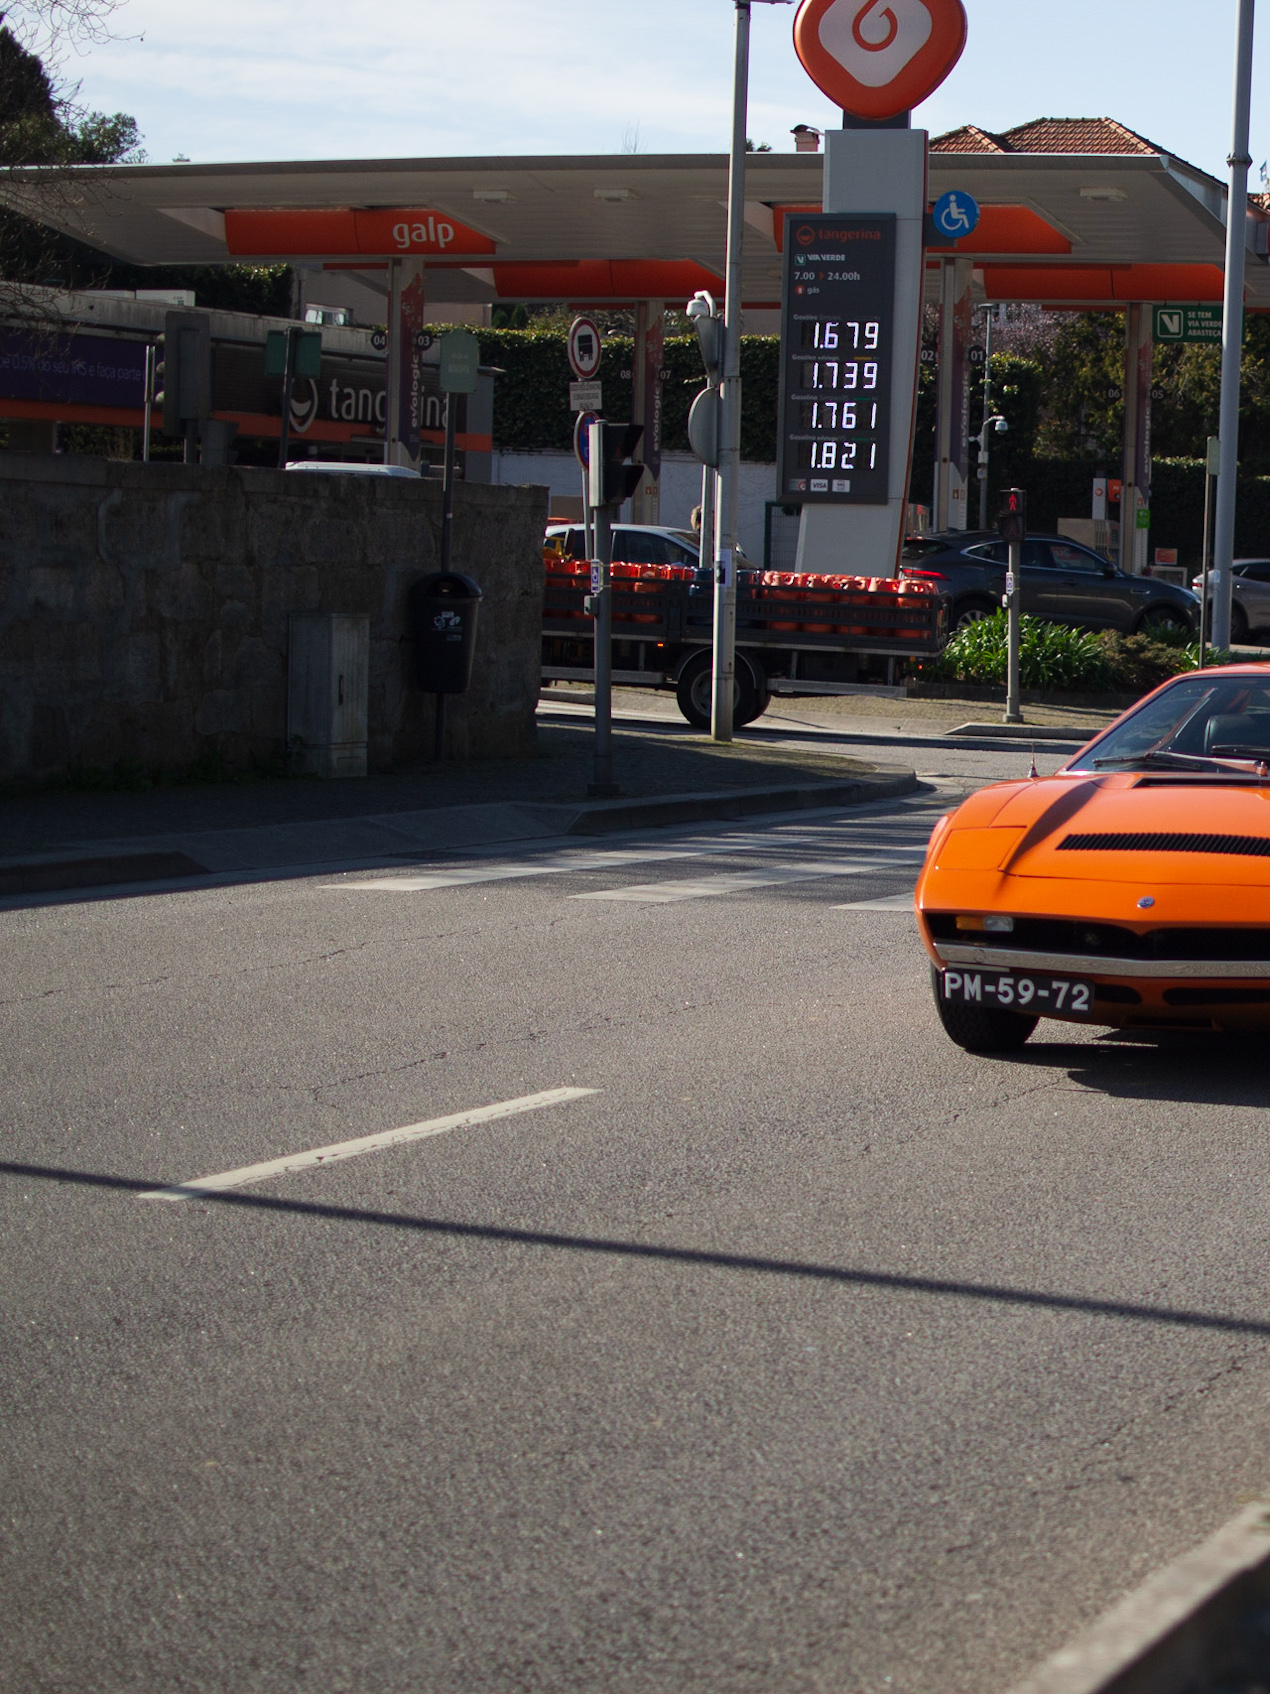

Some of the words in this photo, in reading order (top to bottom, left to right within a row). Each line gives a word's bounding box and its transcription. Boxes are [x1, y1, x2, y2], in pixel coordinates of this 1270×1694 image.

[392, 216, 455, 249] galp
[819, 228, 882, 244] tangerina
[807, 254, 821, 262] VIA
[821, 254, 846, 262] VERDE
[794, 271, 816, 281] 7.00
[827, 270, 861, 281] 24.00h
[1187, 311, 1197, 319] SE
[1198, 311, 1212, 319] TEM
[1187, 320, 1200, 328] VIA
[1201, 320, 1223, 329] VERDE
[373, 334, 386, 346] 04
[417, 334, 431, 347] 03
[813, 321, 880, 350] 1.679
[921, 350, 935, 361] 02
[970, 350, 984, 361] 01
[38, 358, 51, 373] do
[52, 361, 69, 375] seu
[89, 364, 97, 376] e
[97, 361, 115, 380] faça
[117, 367, 141, 383] parte
[660, 370, 672, 380] 07
[812, 361, 879, 389] 1.739
[410, 353, 421, 428] evologic
[1108, 388, 1121, 399] 06
[1152, 389, 1164, 400] 05
[812, 402, 877, 430] 1.761
[961, 370, 970, 448] evologic
[652, 386, 662, 452] evologic
[810, 441, 876, 470] 1.821
[944, 972, 1090, 1011] PM-59-72
